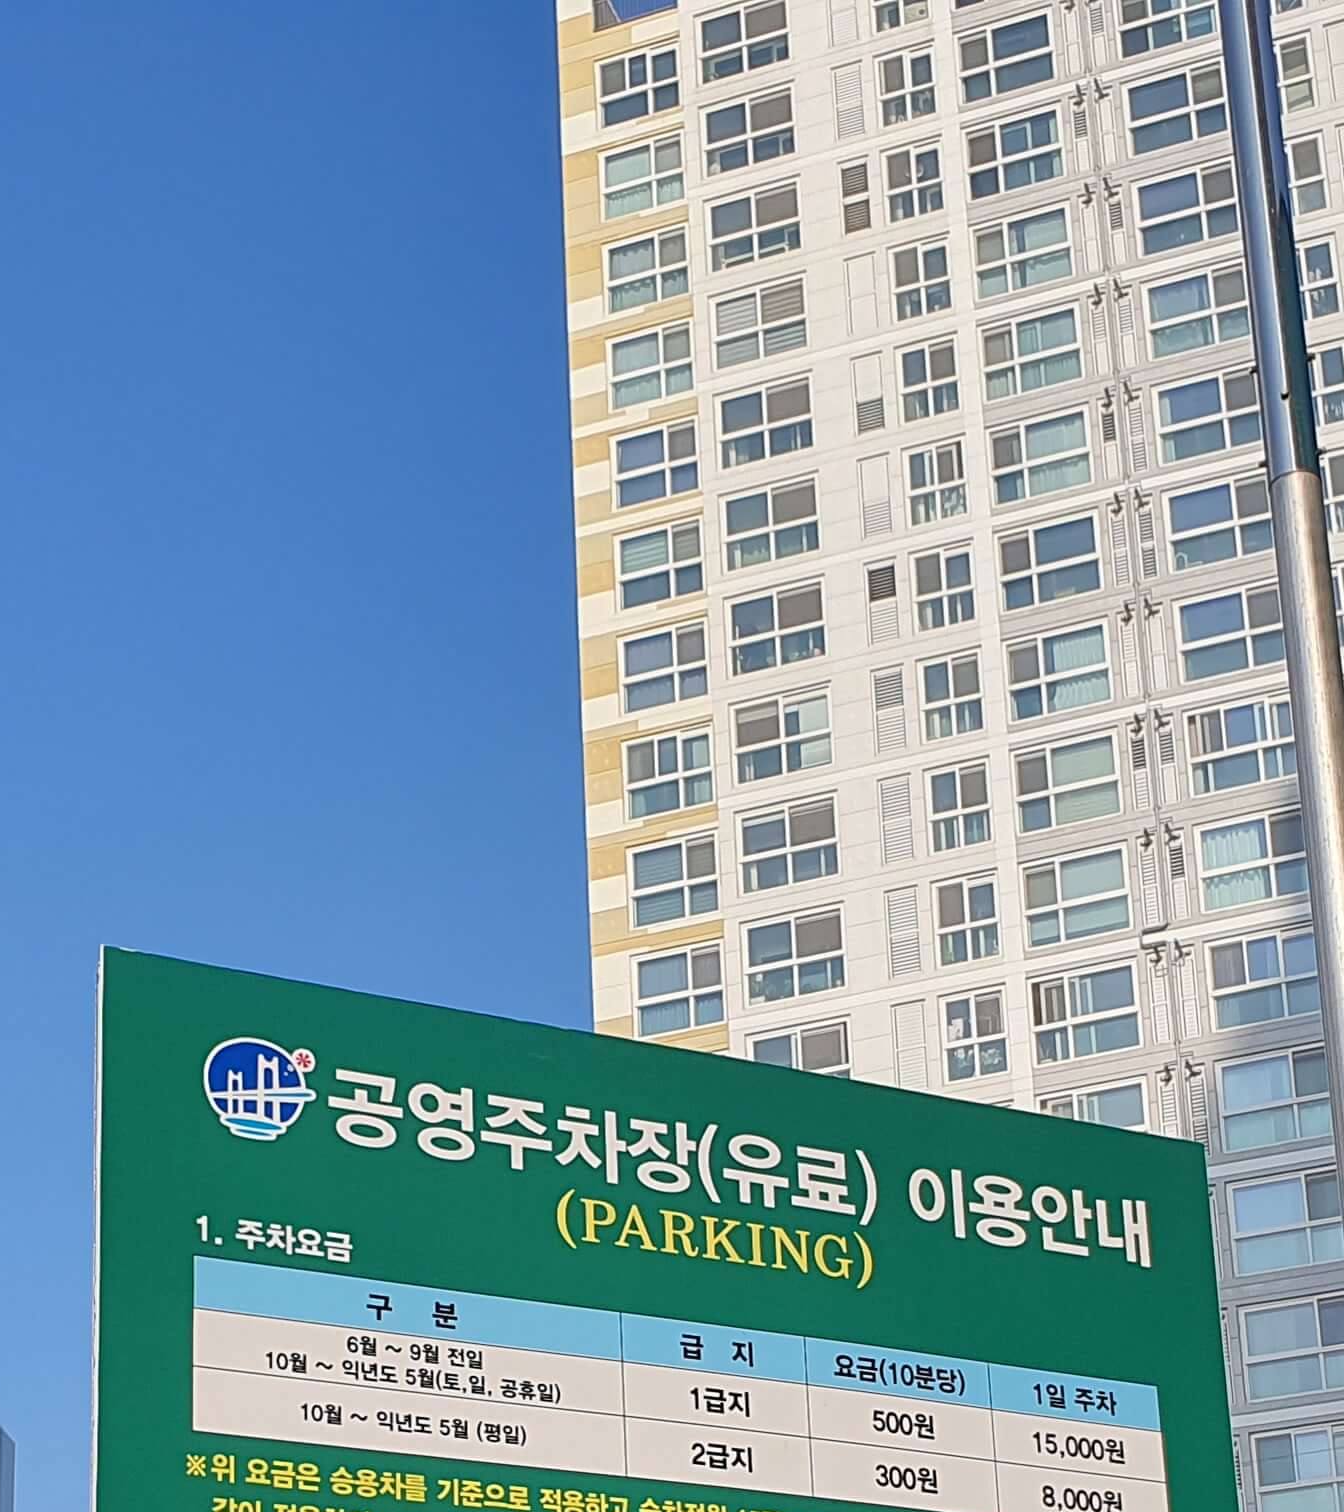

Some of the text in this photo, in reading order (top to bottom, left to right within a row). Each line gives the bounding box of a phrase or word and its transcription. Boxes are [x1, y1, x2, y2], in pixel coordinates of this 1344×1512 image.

[328, 1069, 1151, 1267] 공영주차장(유료) 이용안내
[197, 1216, 352, 1262] 1. 주차요금
[557, 1190, 872, 1288] (PARKING)
[347, 1336, 376, 1357] 6월
[410, 1344, 439, 1364] 9월
[448, 1348, 483, 1370] 전일
[266, 1352, 307, 1374] 10월
[342, 1360, 398, 1383] 익년도
[500, 1379, 560, 1404] 공휴일)
[834, 1355, 966, 1397] 요금(10분당)
[690, 1387, 750, 1417] 1급지
[1033, 1384, 1117, 1415] 1일 주차
[301, 1403, 342, 1425] 10월
[376, 1411, 432, 1434] 익년도
[440, 1419, 468, 1439] 5월
[477, 1421, 526, 1446] (평일)
[871, 1410, 936, 1440] 500원
[692, 1443, 753, 1473] 2급지
[1033, 1432, 1125, 1464] 15,000원
[246, 1459, 320, 1491] 요금은
[330, 1467, 427, 1502] 승용차를
[438, 1479, 530, 1510] 기준으로
[876, 1464, 938, 1494] 300원
